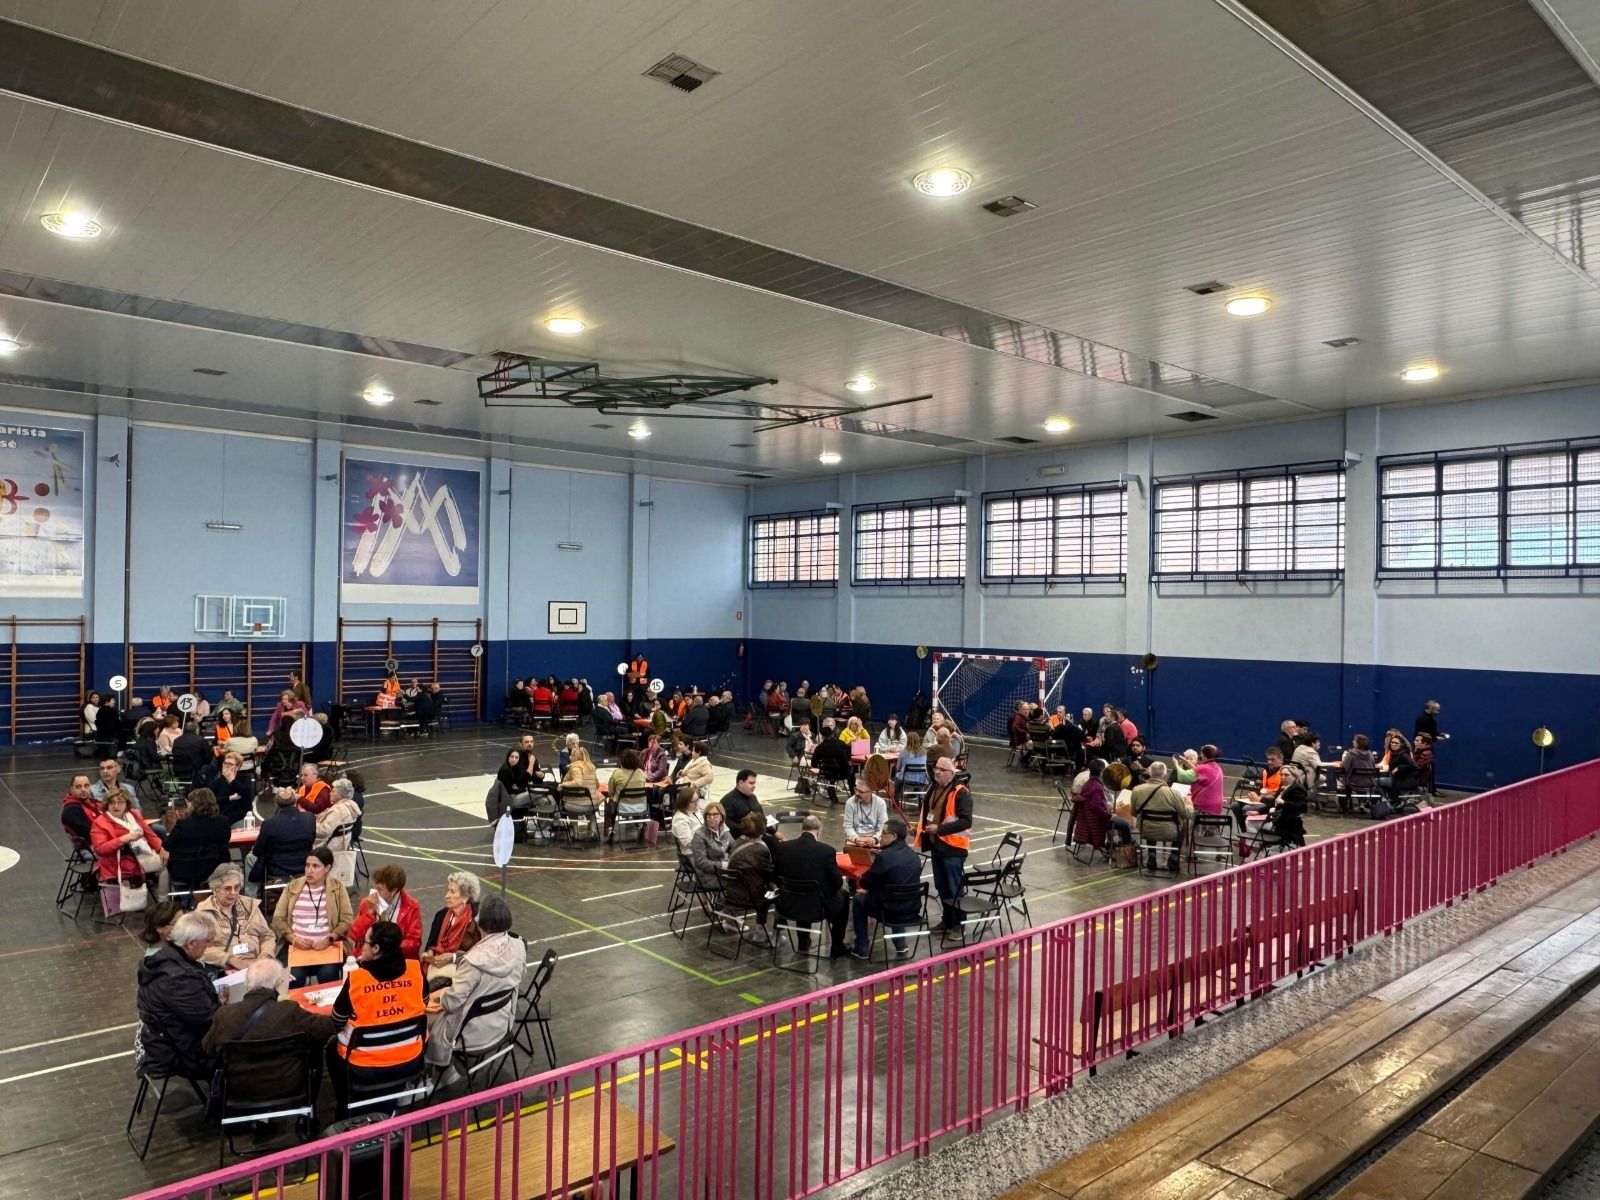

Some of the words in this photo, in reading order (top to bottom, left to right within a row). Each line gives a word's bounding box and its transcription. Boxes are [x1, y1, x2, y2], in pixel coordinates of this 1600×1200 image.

[472, 646, 481, 656] 7
[387, 659, 395, 669] 6
[114, 679, 123, 689] 5
[651, 681, 661, 691] 15
[179, 697, 193, 710] 13
[382, 994, 397, 1004] DE
[376, 1005, 404, 1018] LEÓN
